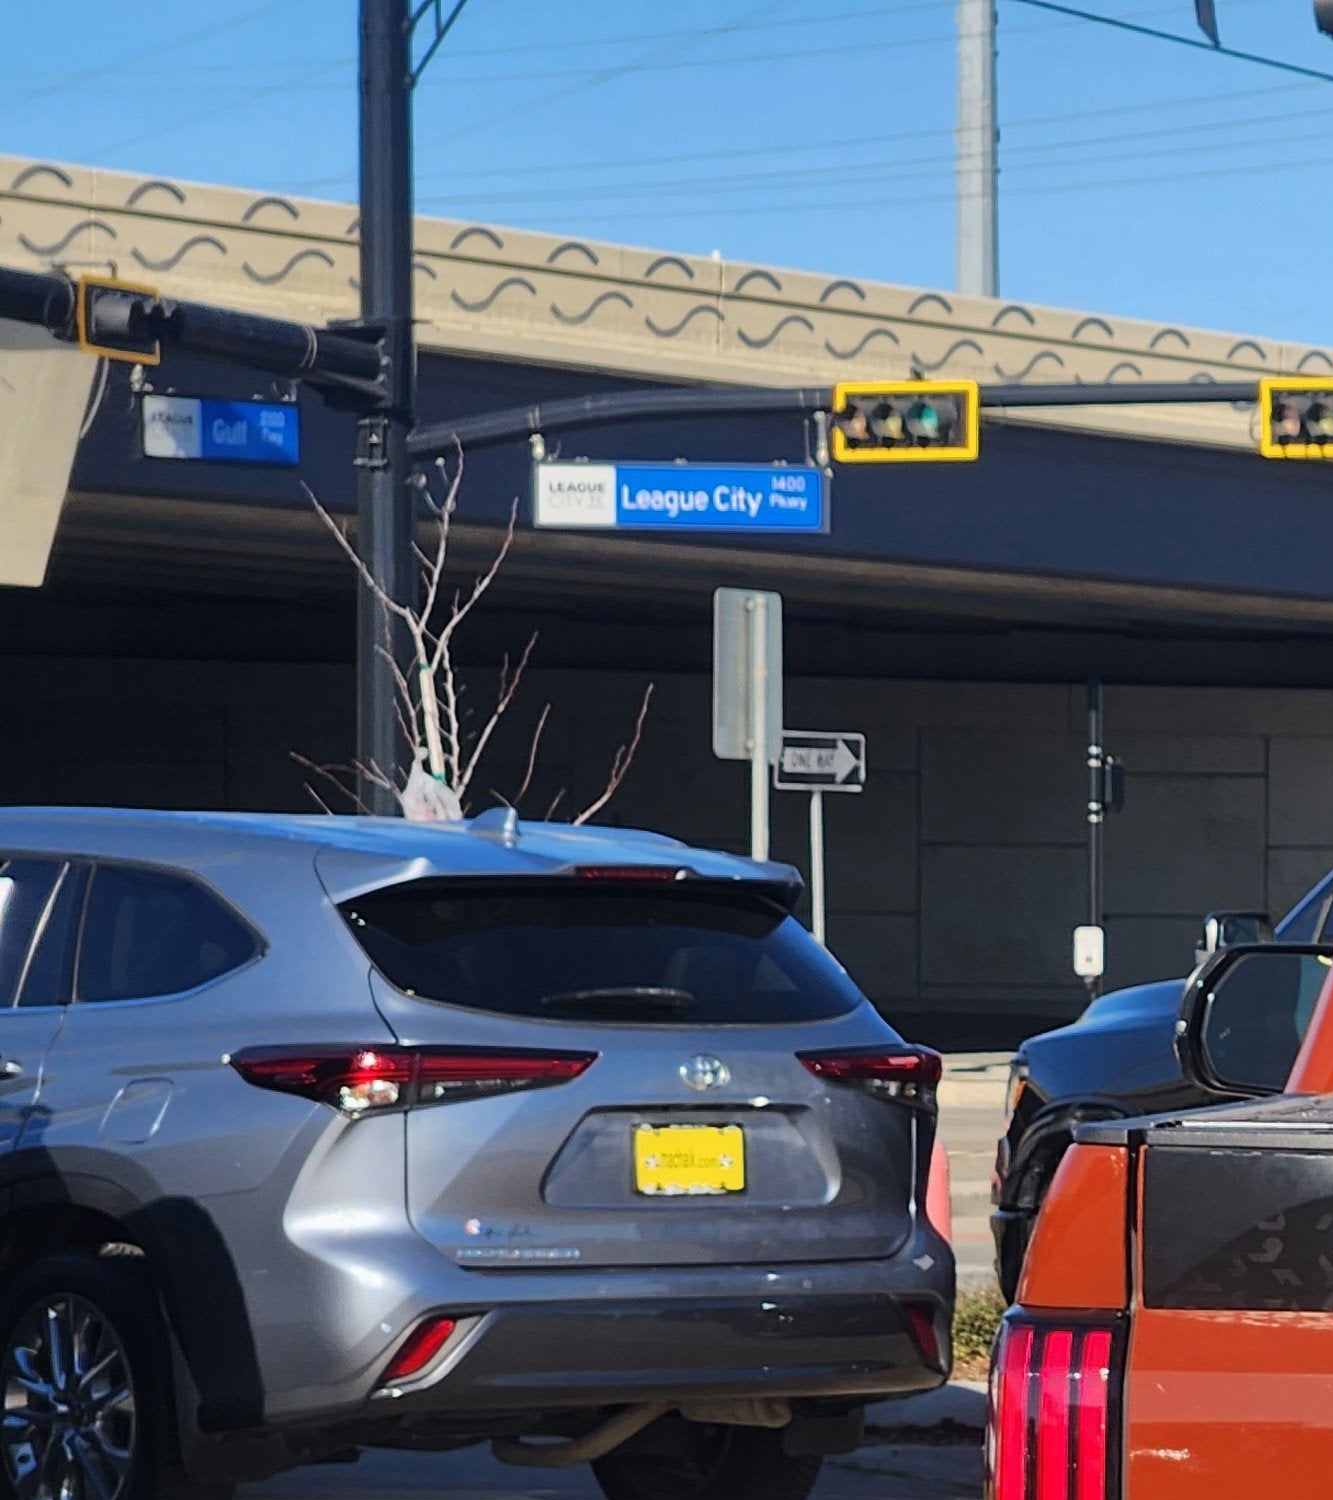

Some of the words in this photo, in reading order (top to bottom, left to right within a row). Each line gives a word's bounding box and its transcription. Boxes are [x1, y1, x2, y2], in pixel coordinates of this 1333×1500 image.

[212, 417, 248, 445] Gulf
[548, 481, 606, 492] LEAGUE
[771, 475, 806, 491] 1400
[621, 484, 709, 518] League
[712, 484, 764, 518] City
[769, 493, 808, 511] Pkwy
